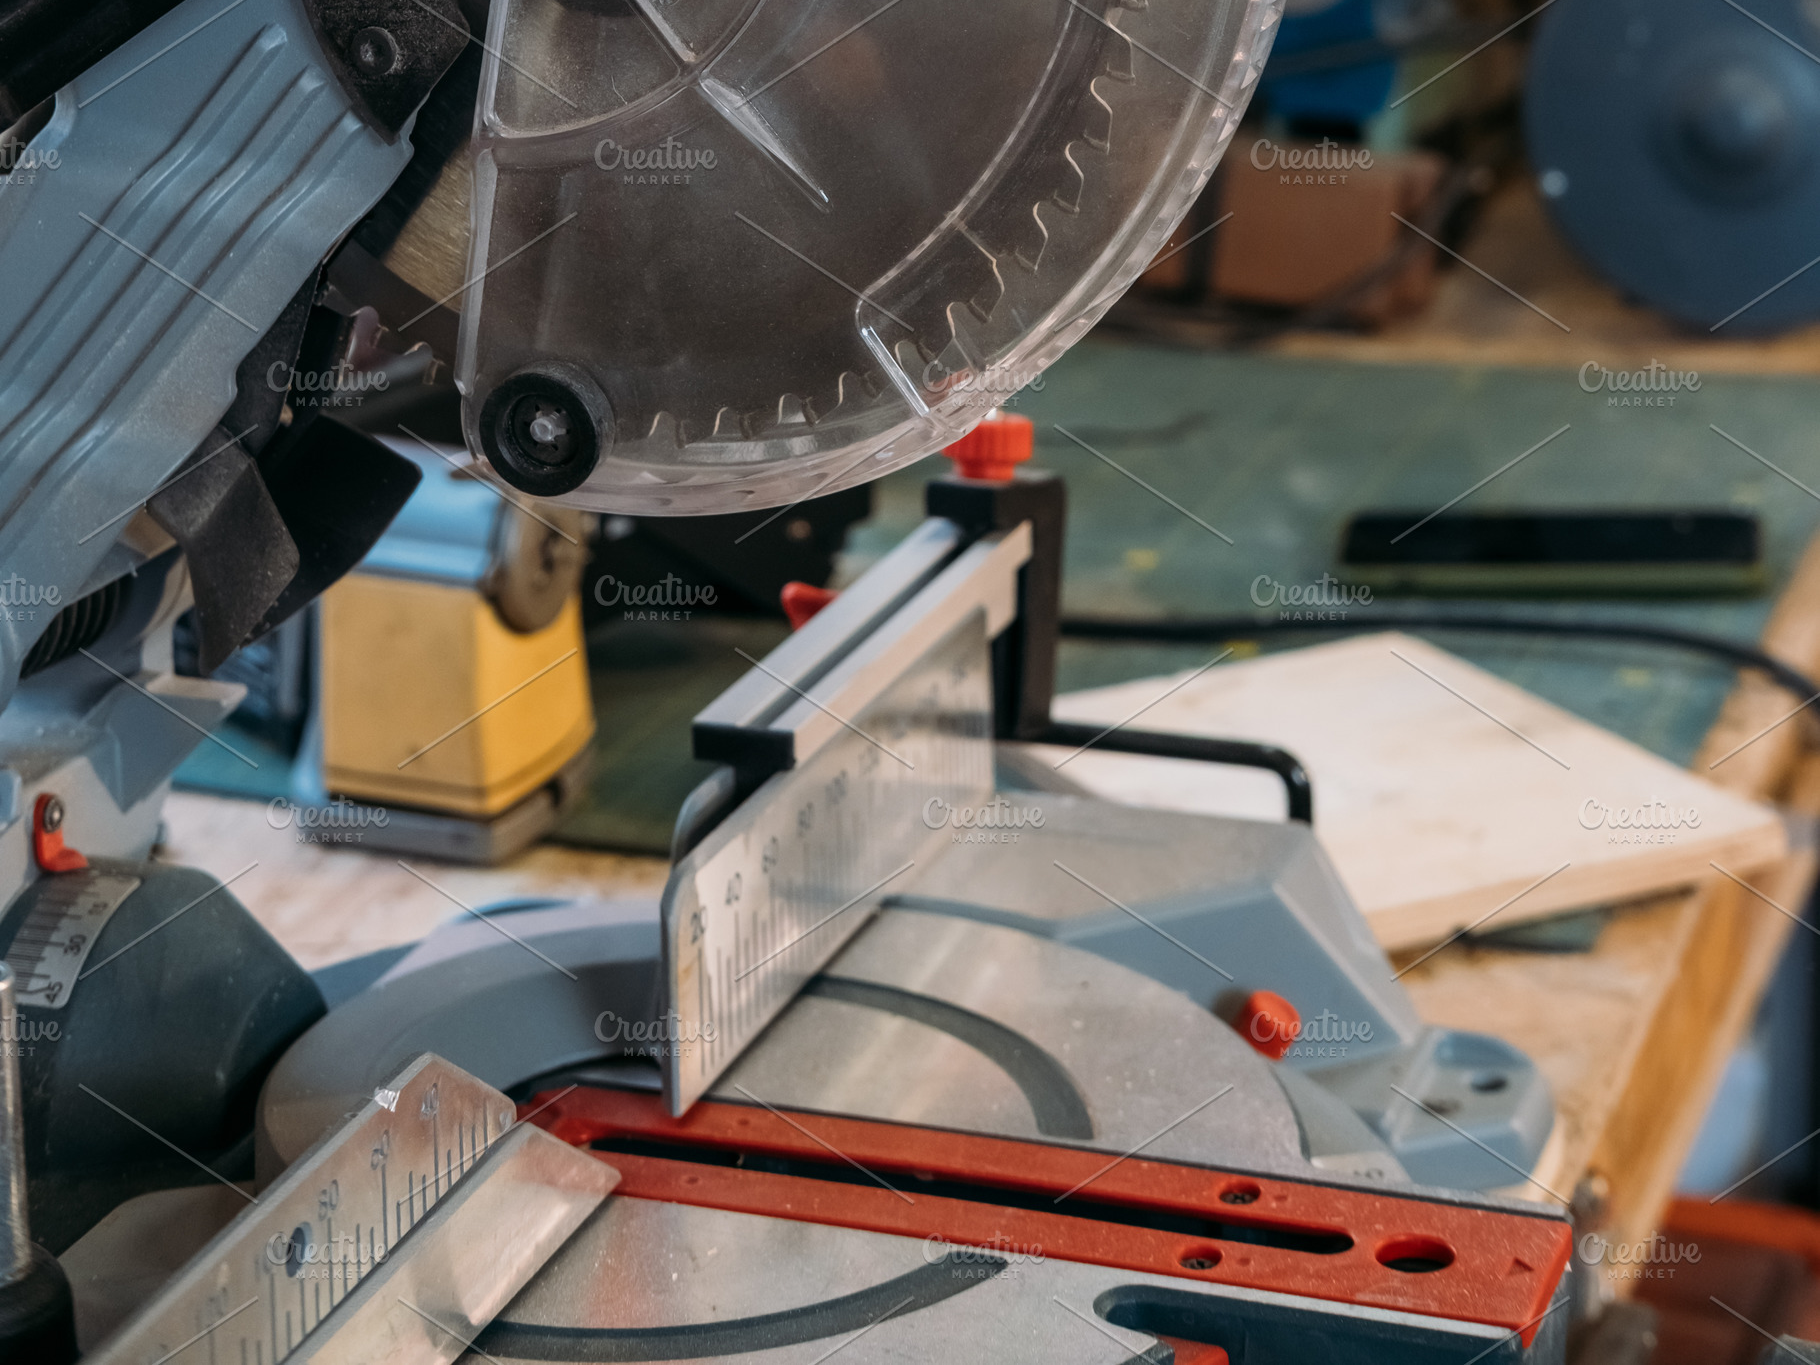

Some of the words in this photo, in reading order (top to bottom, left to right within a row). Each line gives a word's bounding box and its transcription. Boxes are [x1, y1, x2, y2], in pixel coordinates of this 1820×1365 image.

[690, 905, 708, 945] 20
[44, 981, 63, 1004] 45
[63, 933, 87, 957] 30
[317, 1178, 340, 1222] 80
